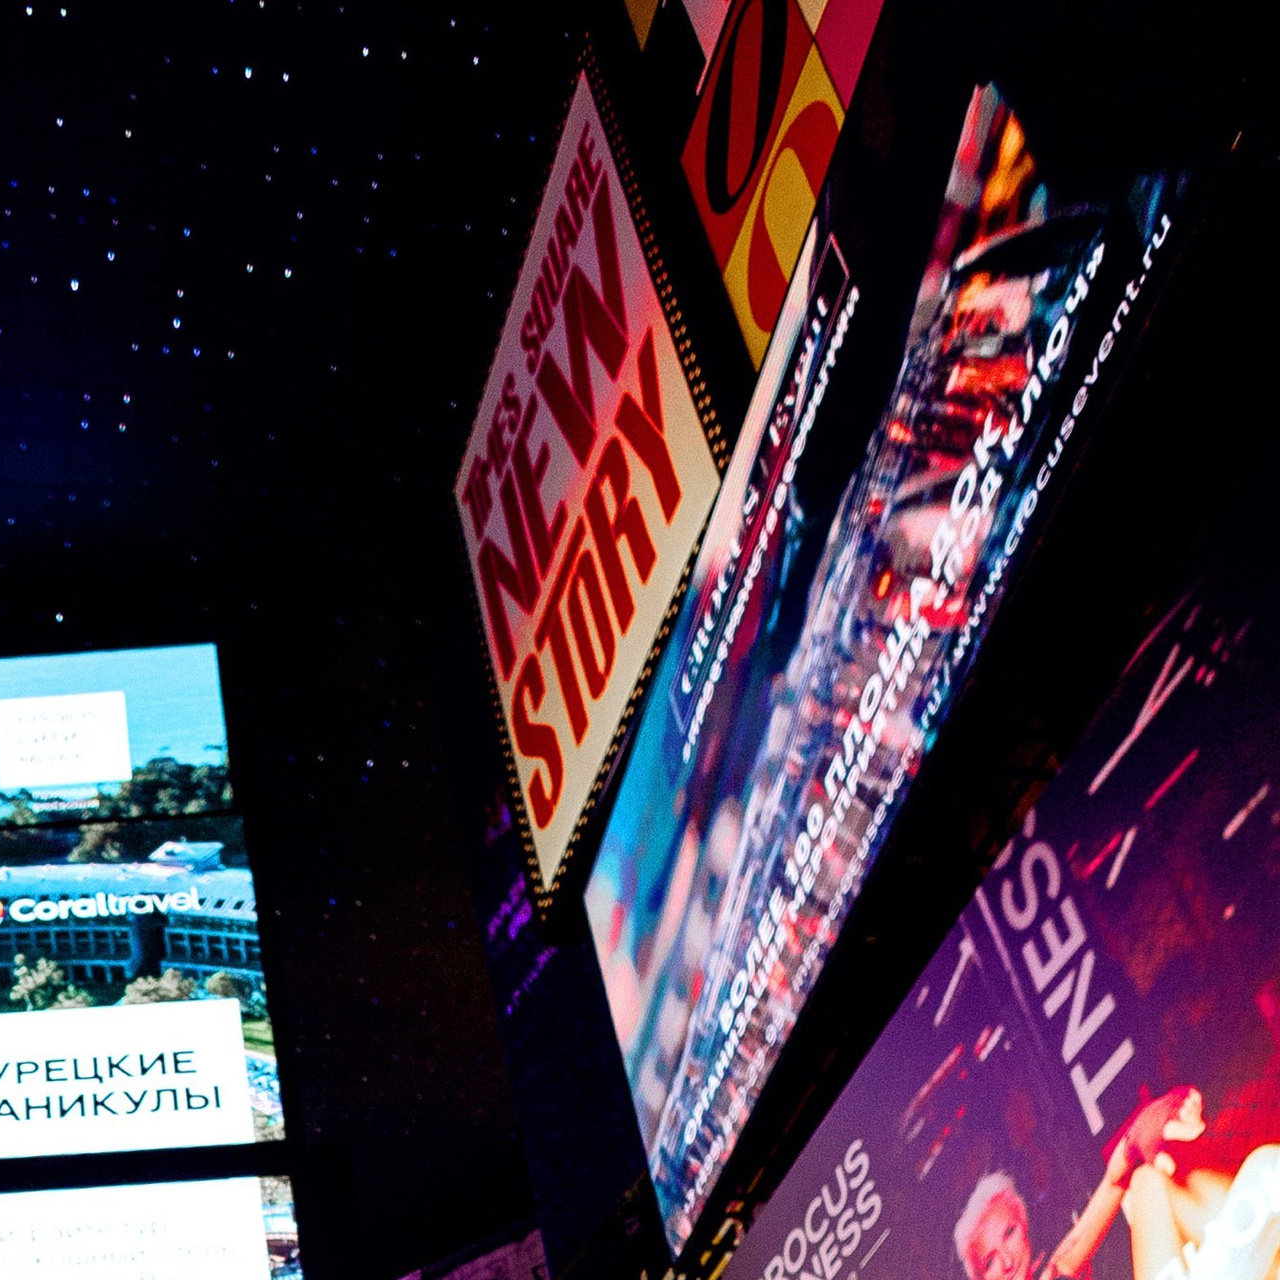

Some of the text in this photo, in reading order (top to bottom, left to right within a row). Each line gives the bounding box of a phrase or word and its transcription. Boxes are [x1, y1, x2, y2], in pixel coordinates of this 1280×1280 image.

[477, 168, 630, 682] NEW
[522, 121, 603, 373] SQUARE
[950, 212, 1176, 666] www.crocusevent.ru
[998, 240, 1109, 459] КЛЮЧ»
[511, 326, 682, 830] STORY
[718, 405, 1008, 1041] БОЛЕЕ 100 ПЛОЩАДОК
